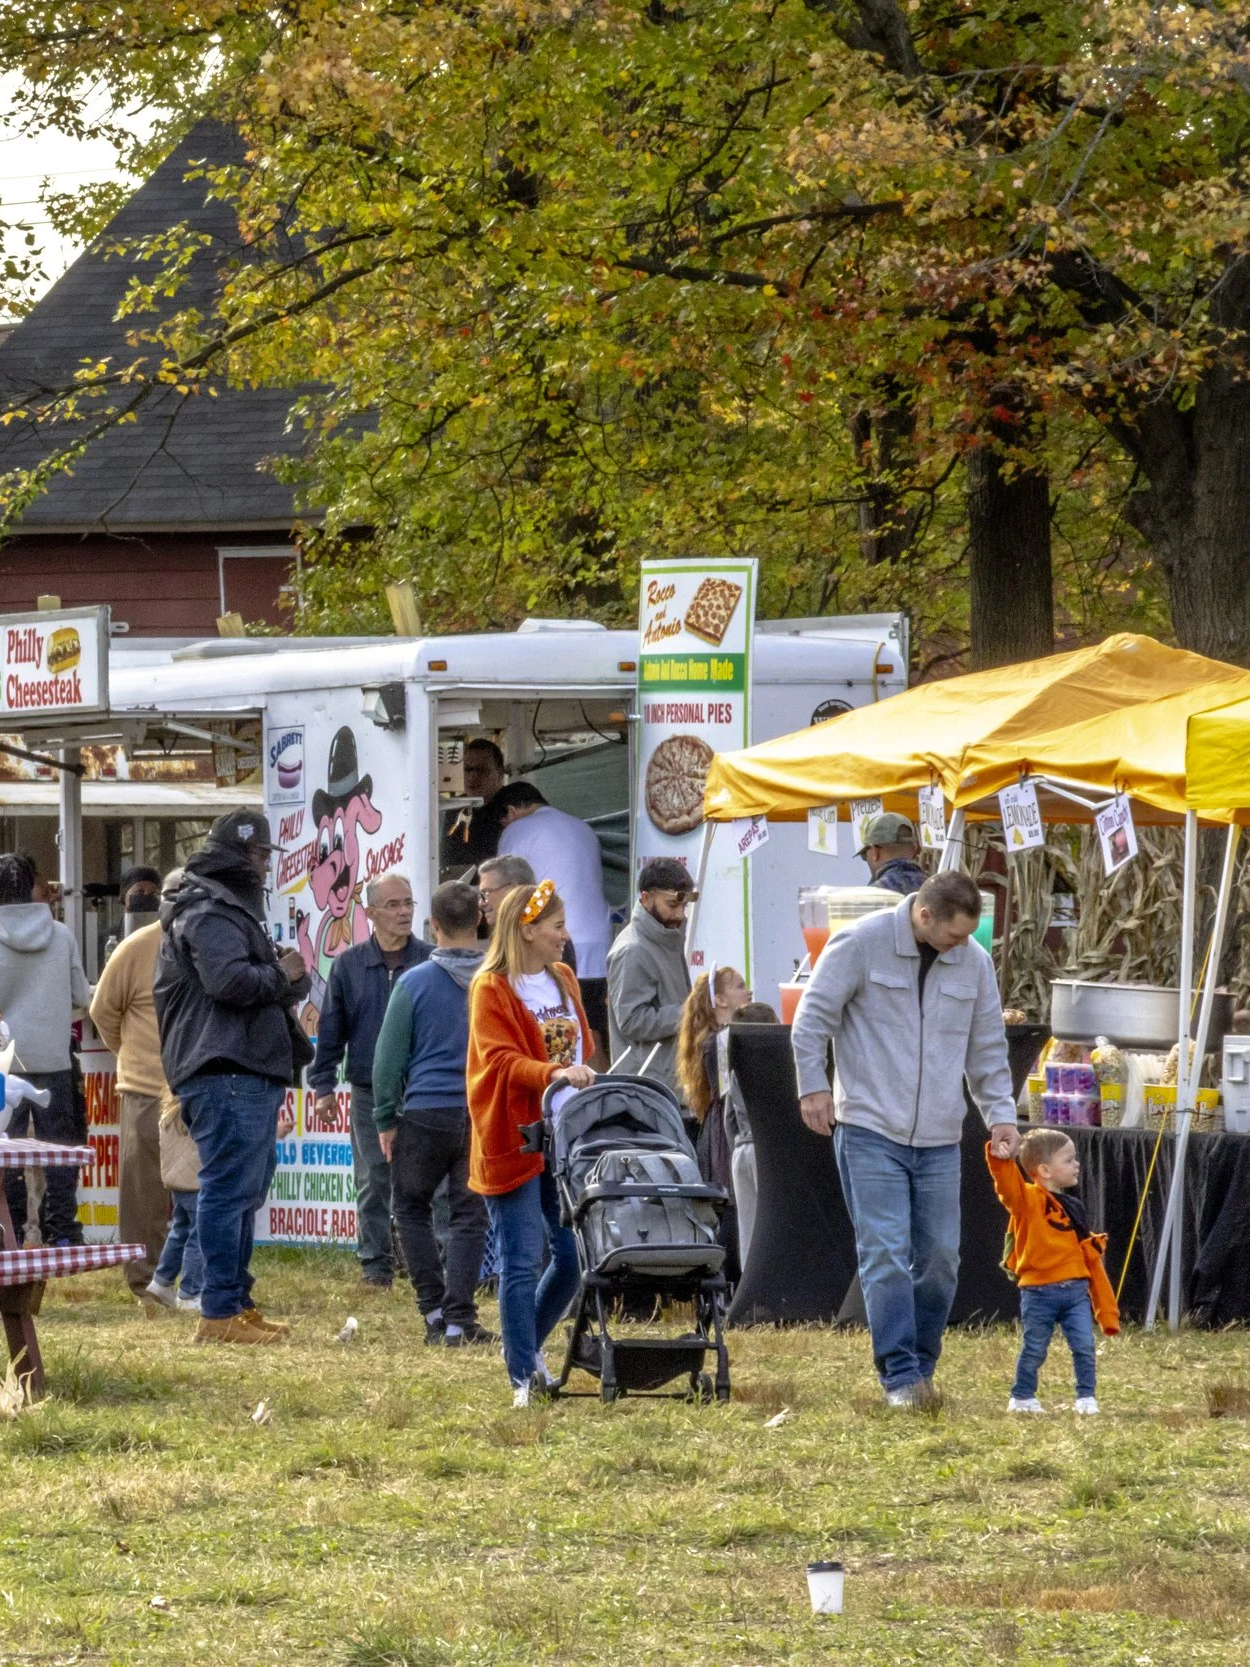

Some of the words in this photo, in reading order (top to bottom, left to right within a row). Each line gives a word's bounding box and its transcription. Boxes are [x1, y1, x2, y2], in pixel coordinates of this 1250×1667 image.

[647, 579, 676, 609] Rocco
[655, 603, 667, 622] and
[6, 627, 44, 670] Philly
[642, 616, 681, 649] Antonio
[688, 657, 708, 681] Home
[710, 656, 734, 681] Made
[6, 669, 83, 709] Cheesesteak
[651, 703, 665, 724] INCH
[666, 703, 705, 724] PERSONAL
[707, 703, 733, 725] PIES
[270, 732, 303, 769] SABRETT
[278, 807, 306, 848] PHILLY
[1003, 801, 1039, 830] LEMONADE
[738, 824, 760, 855] AREPAS
[363, 832, 406, 883] SAUSAGE
[83, 1071, 120, 1126] USAG
[305, 1090, 352, 1134] CHSE
[270, 1171, 302, 1201] PHILLY
[303, 1172, 344, 1202] CHICKEN
[269, 1206, 328, 1236] BRACIOLE
[331, 1208, 359, 1238] RAB
